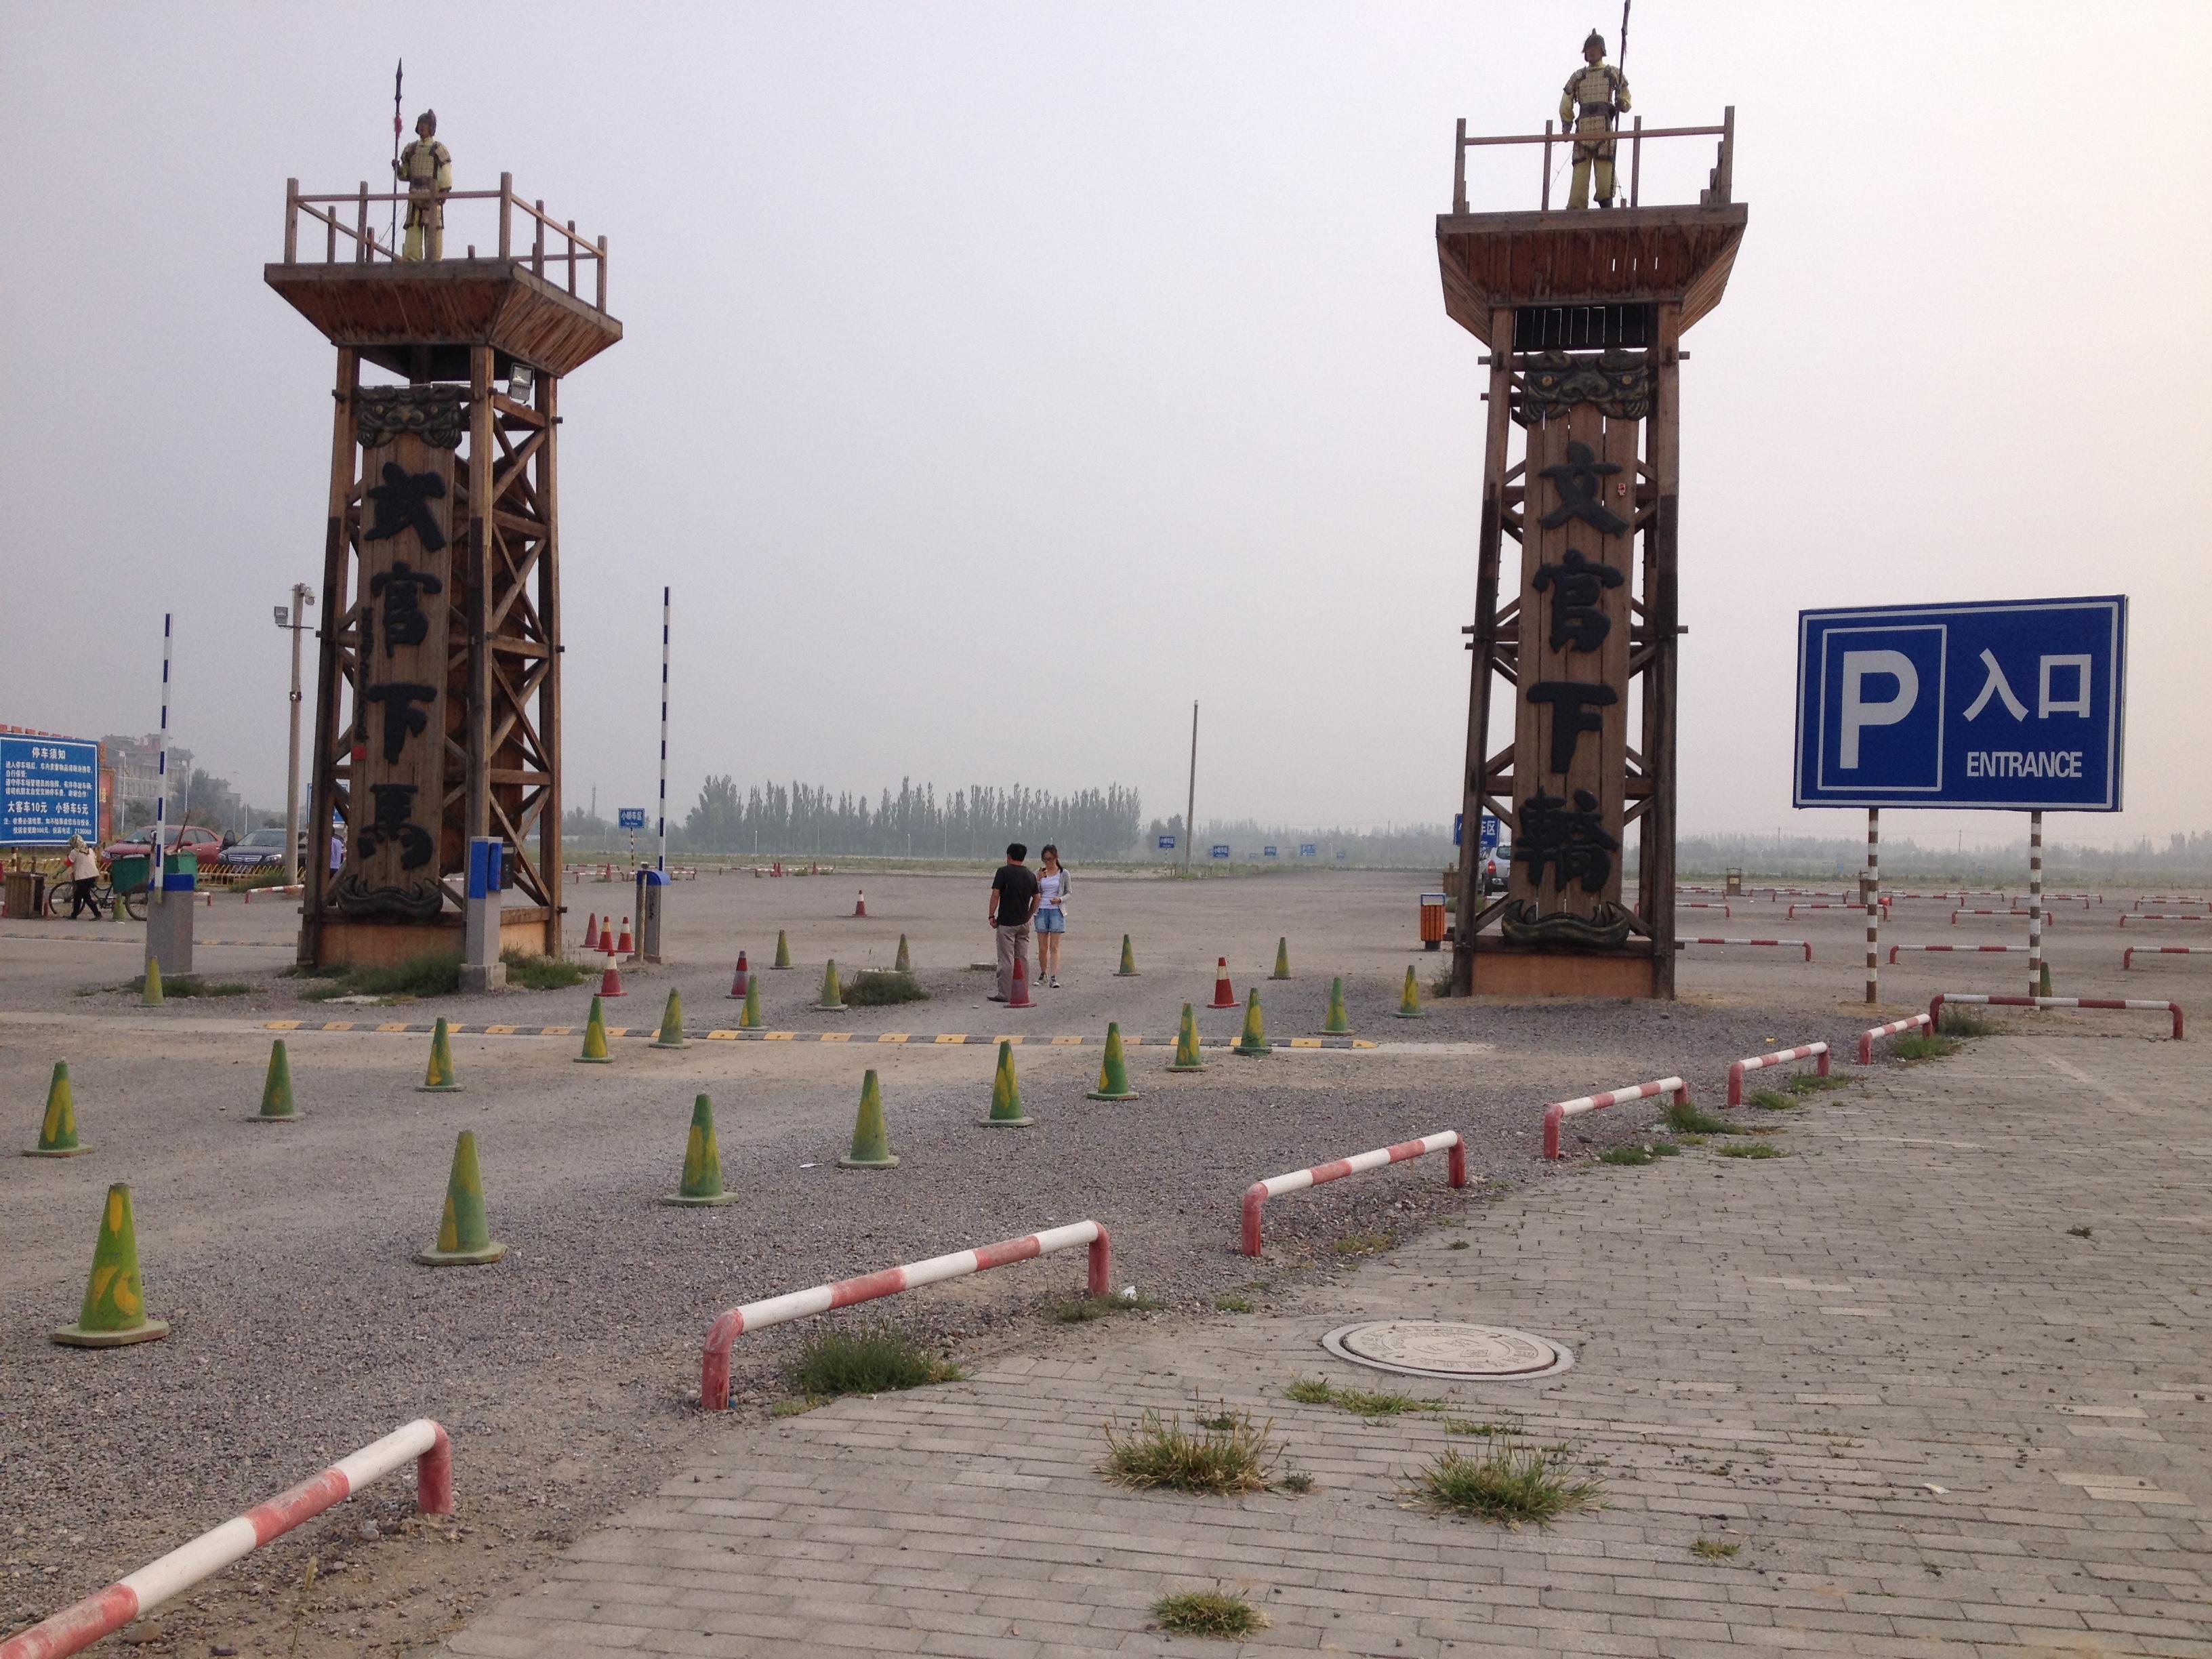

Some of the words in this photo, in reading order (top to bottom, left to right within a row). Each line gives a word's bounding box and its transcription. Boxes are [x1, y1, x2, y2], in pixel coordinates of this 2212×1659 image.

[1963, 648, 2091, 722] 入口
[1840, 650, 1919, 769] P
[32, 747, 66, 760] 停车须知
[1967, 752, 2083, 778] ENTRANCE
[7, 800, 47, 813] 大客车10元
[56, 802, 89, 815] 小轿车5元
